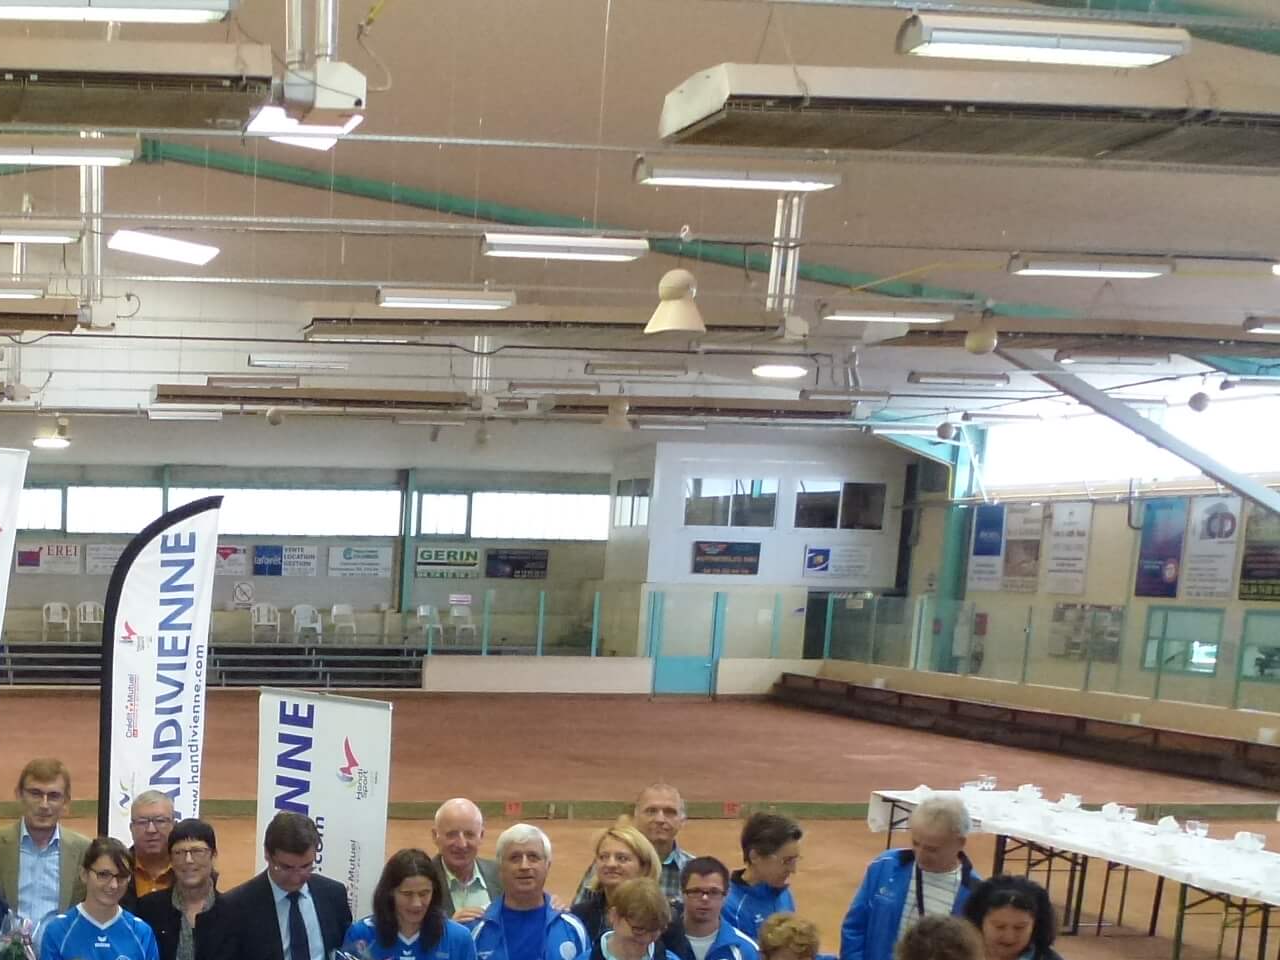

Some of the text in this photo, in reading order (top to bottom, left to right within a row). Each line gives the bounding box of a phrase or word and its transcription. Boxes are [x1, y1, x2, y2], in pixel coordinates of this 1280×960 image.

[420, 550, 478, 561] GERIN
[127, 673, 135, 703] Mutuel
[348, 839, 357, 881] Mutuel
